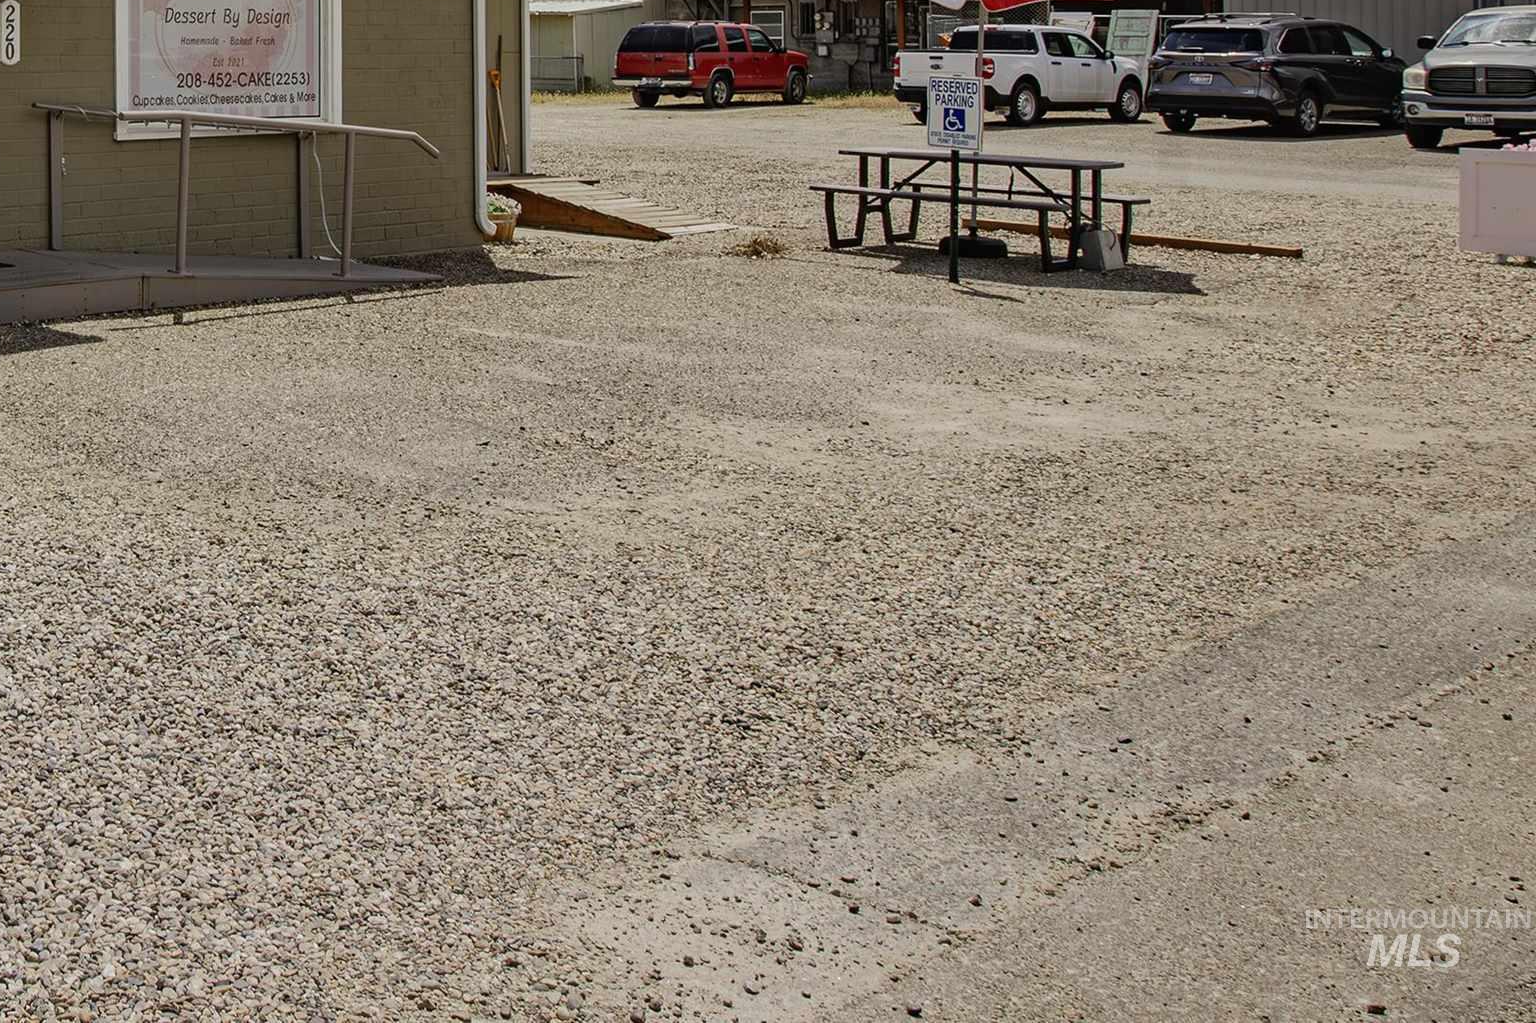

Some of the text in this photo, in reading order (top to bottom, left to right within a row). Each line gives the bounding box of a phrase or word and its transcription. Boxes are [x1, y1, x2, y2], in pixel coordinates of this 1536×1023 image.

[165, 7, 290, 28] Dessert By Design
[5, 4, 15, 60] 220
[181, 36, 219, 45] Homemade
[230, 36, 253, 45] Baked
[256, 36, 275, 45] Fresh
[176, 71, 311, 88] 208-452-CAKE(2253)
[931, 79, 978, 95] RESERVED
[296, 91, 316, 103] More
[935, 93, 974, 108] PARKING
